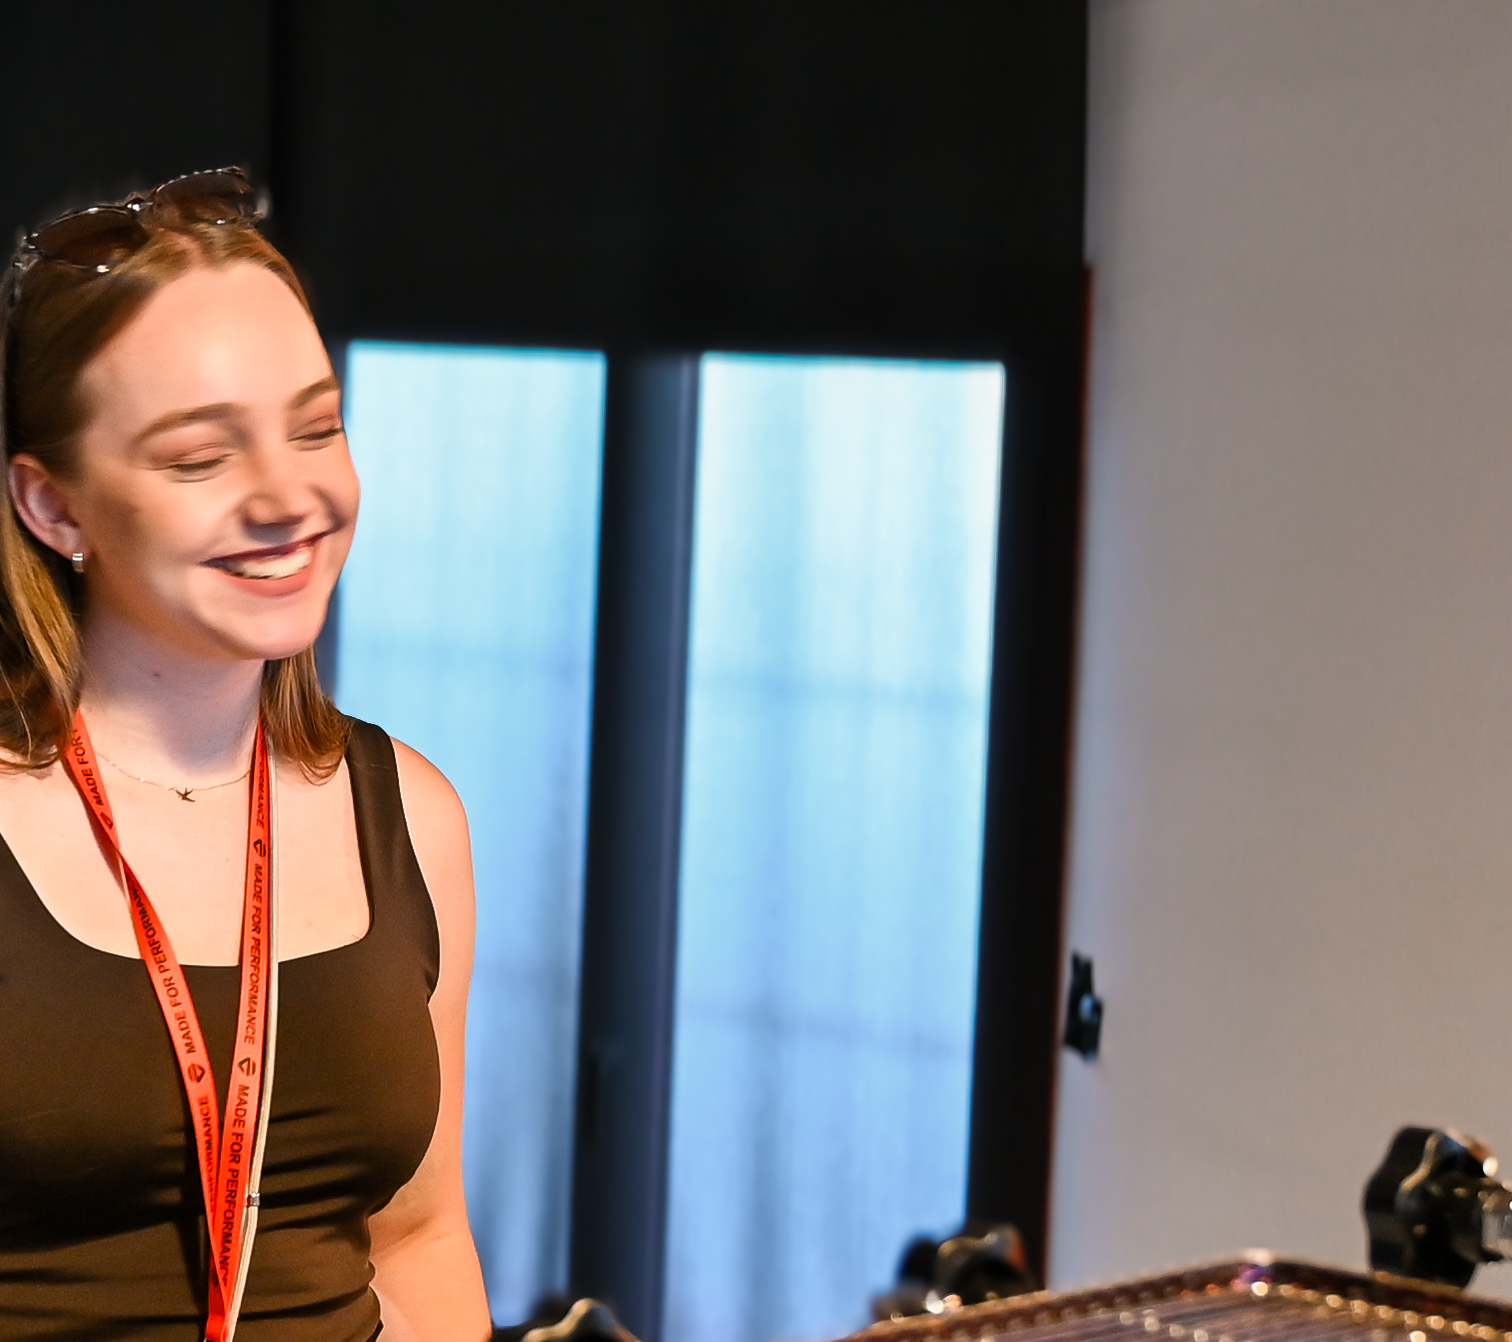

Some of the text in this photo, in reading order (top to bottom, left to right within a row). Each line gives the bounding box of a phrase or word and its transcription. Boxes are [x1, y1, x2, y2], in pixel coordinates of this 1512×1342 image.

[72, 734, 104, 806] MADE FOR
[243, 863, 263, 1046] MADE FOR PERFORMANCE
[162, 974, 182, 1008] FOR
[174, 1009, 196, 1054] MADE
[219, 1084, 250, 1288] MADE FOR PERFORMAN
